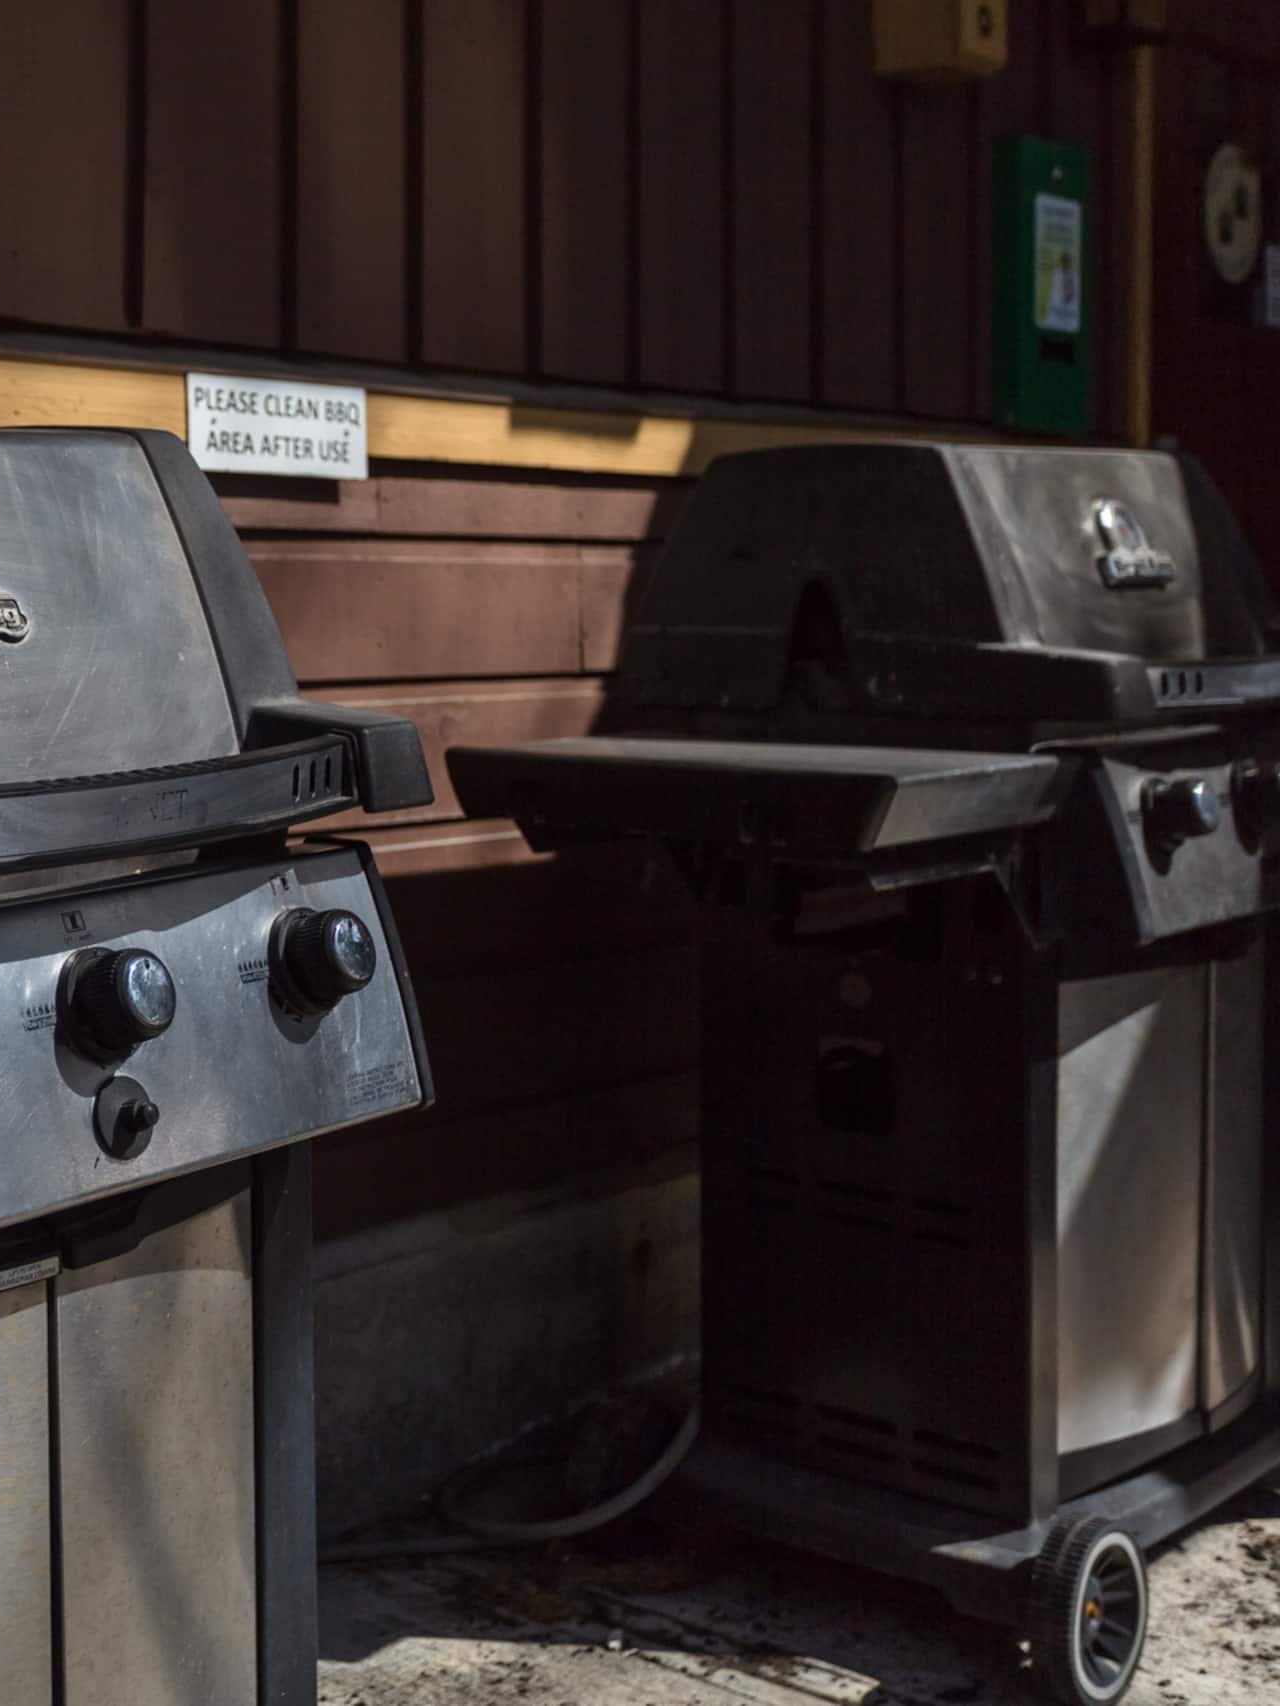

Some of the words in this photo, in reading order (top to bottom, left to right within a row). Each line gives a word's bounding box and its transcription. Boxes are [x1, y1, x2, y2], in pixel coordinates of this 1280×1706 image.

[194, 386, 259, 415] PLEASE
[263, 393, 319, 420] CLEAN
[324, 400, 361, 426] BBQ
[206, 430, 255, 455] AREA
[259, 434, 315, 461] AFTER
[319, 440, 351, 464] USE
